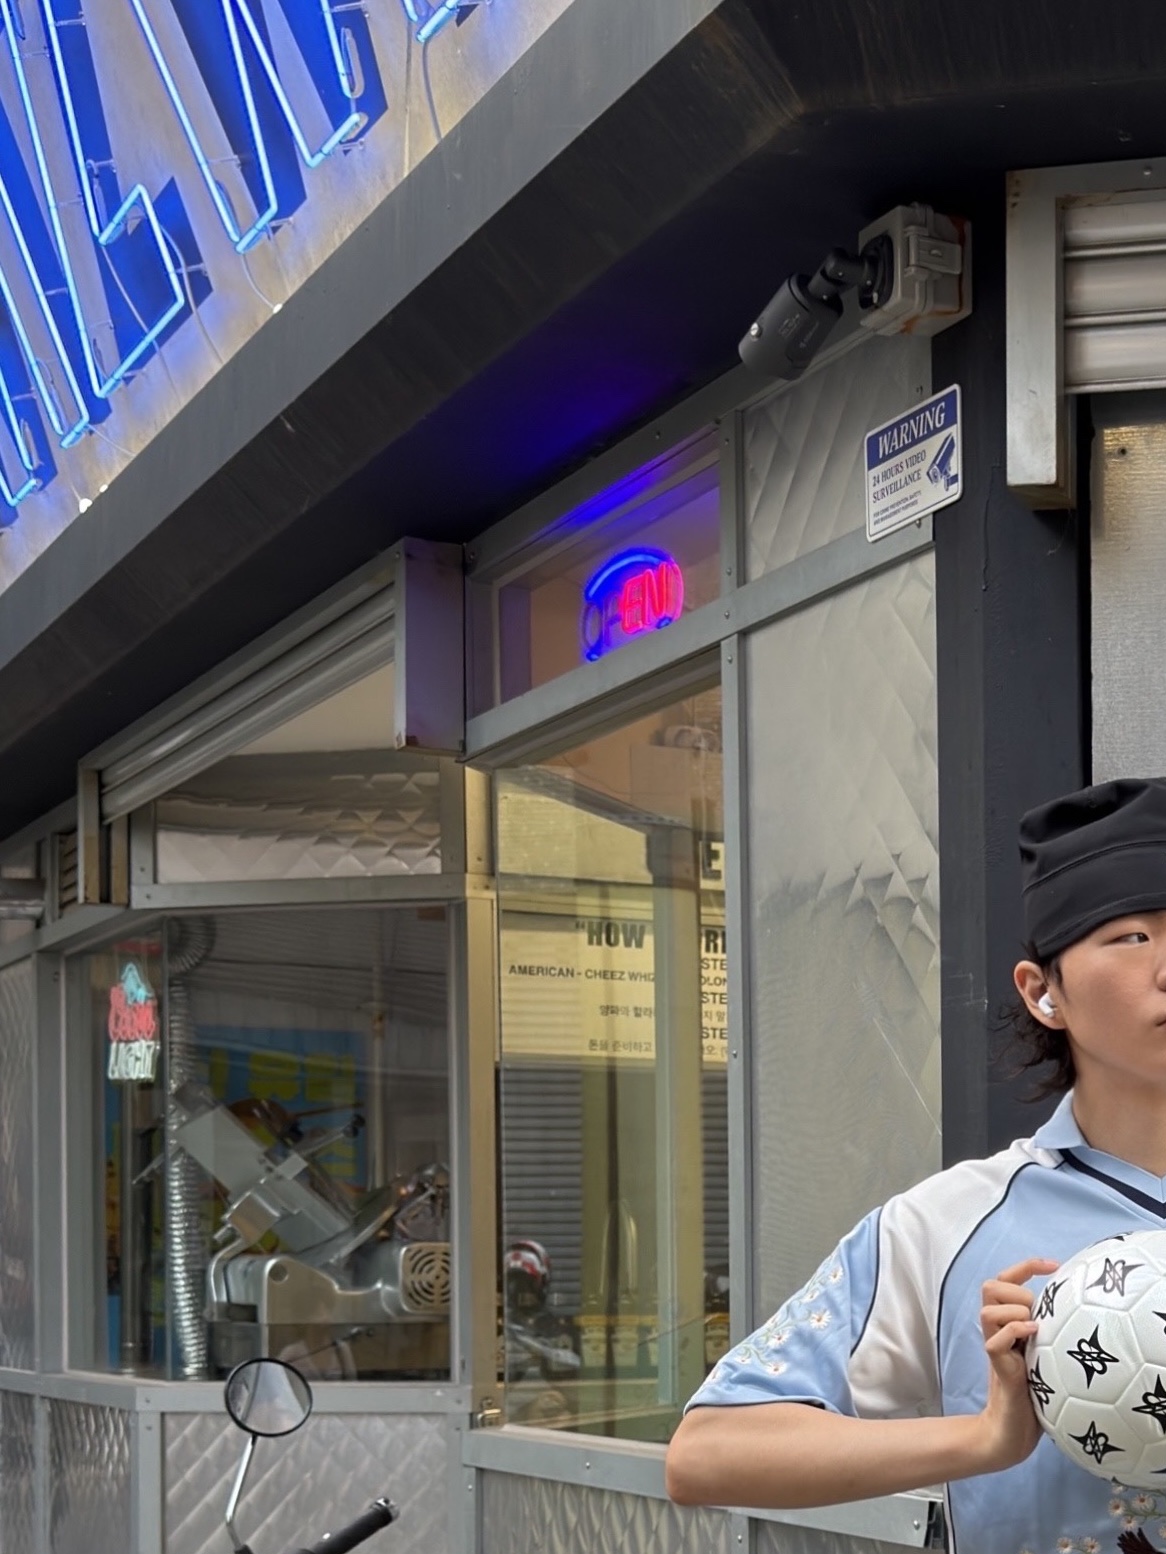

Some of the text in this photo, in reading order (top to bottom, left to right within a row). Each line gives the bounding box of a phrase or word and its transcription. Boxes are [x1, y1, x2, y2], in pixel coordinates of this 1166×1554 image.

[878, 402, 945, 459] WARNING
[872, 450, 926, 487] 24 HOURS VIDEO
[873, 469, 922, 503] SURVEILLANCE
[508, 964, 575, 978] AMERICAN
[585, 968, 625, 981] CHEEZ
